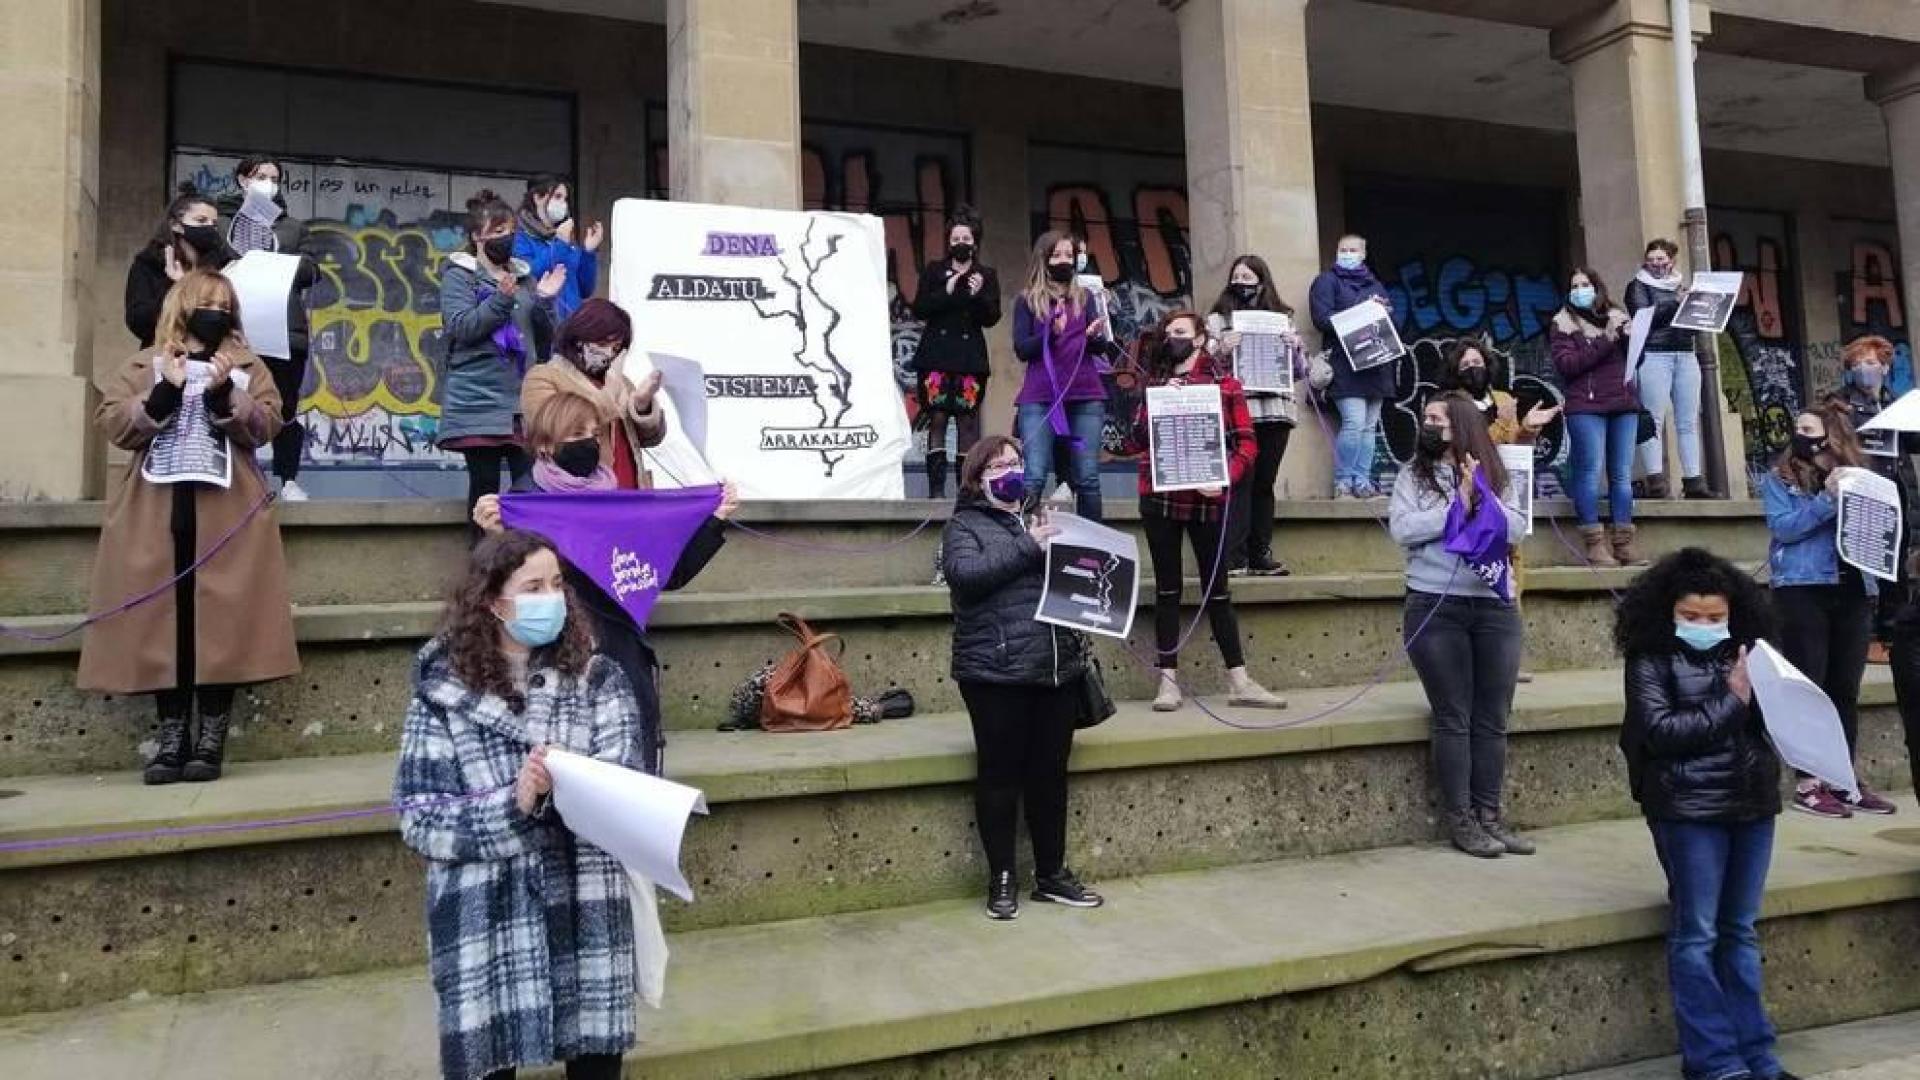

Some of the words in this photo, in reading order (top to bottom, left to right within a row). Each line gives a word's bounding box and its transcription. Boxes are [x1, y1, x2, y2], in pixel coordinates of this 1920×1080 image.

[709, 234, 778, 256] DENA
[655, 278, 759, 300] ALDATU
[704, 377, 812, 396] SISTEMA
[763, 429, 875, 448] ARRAKALATU
